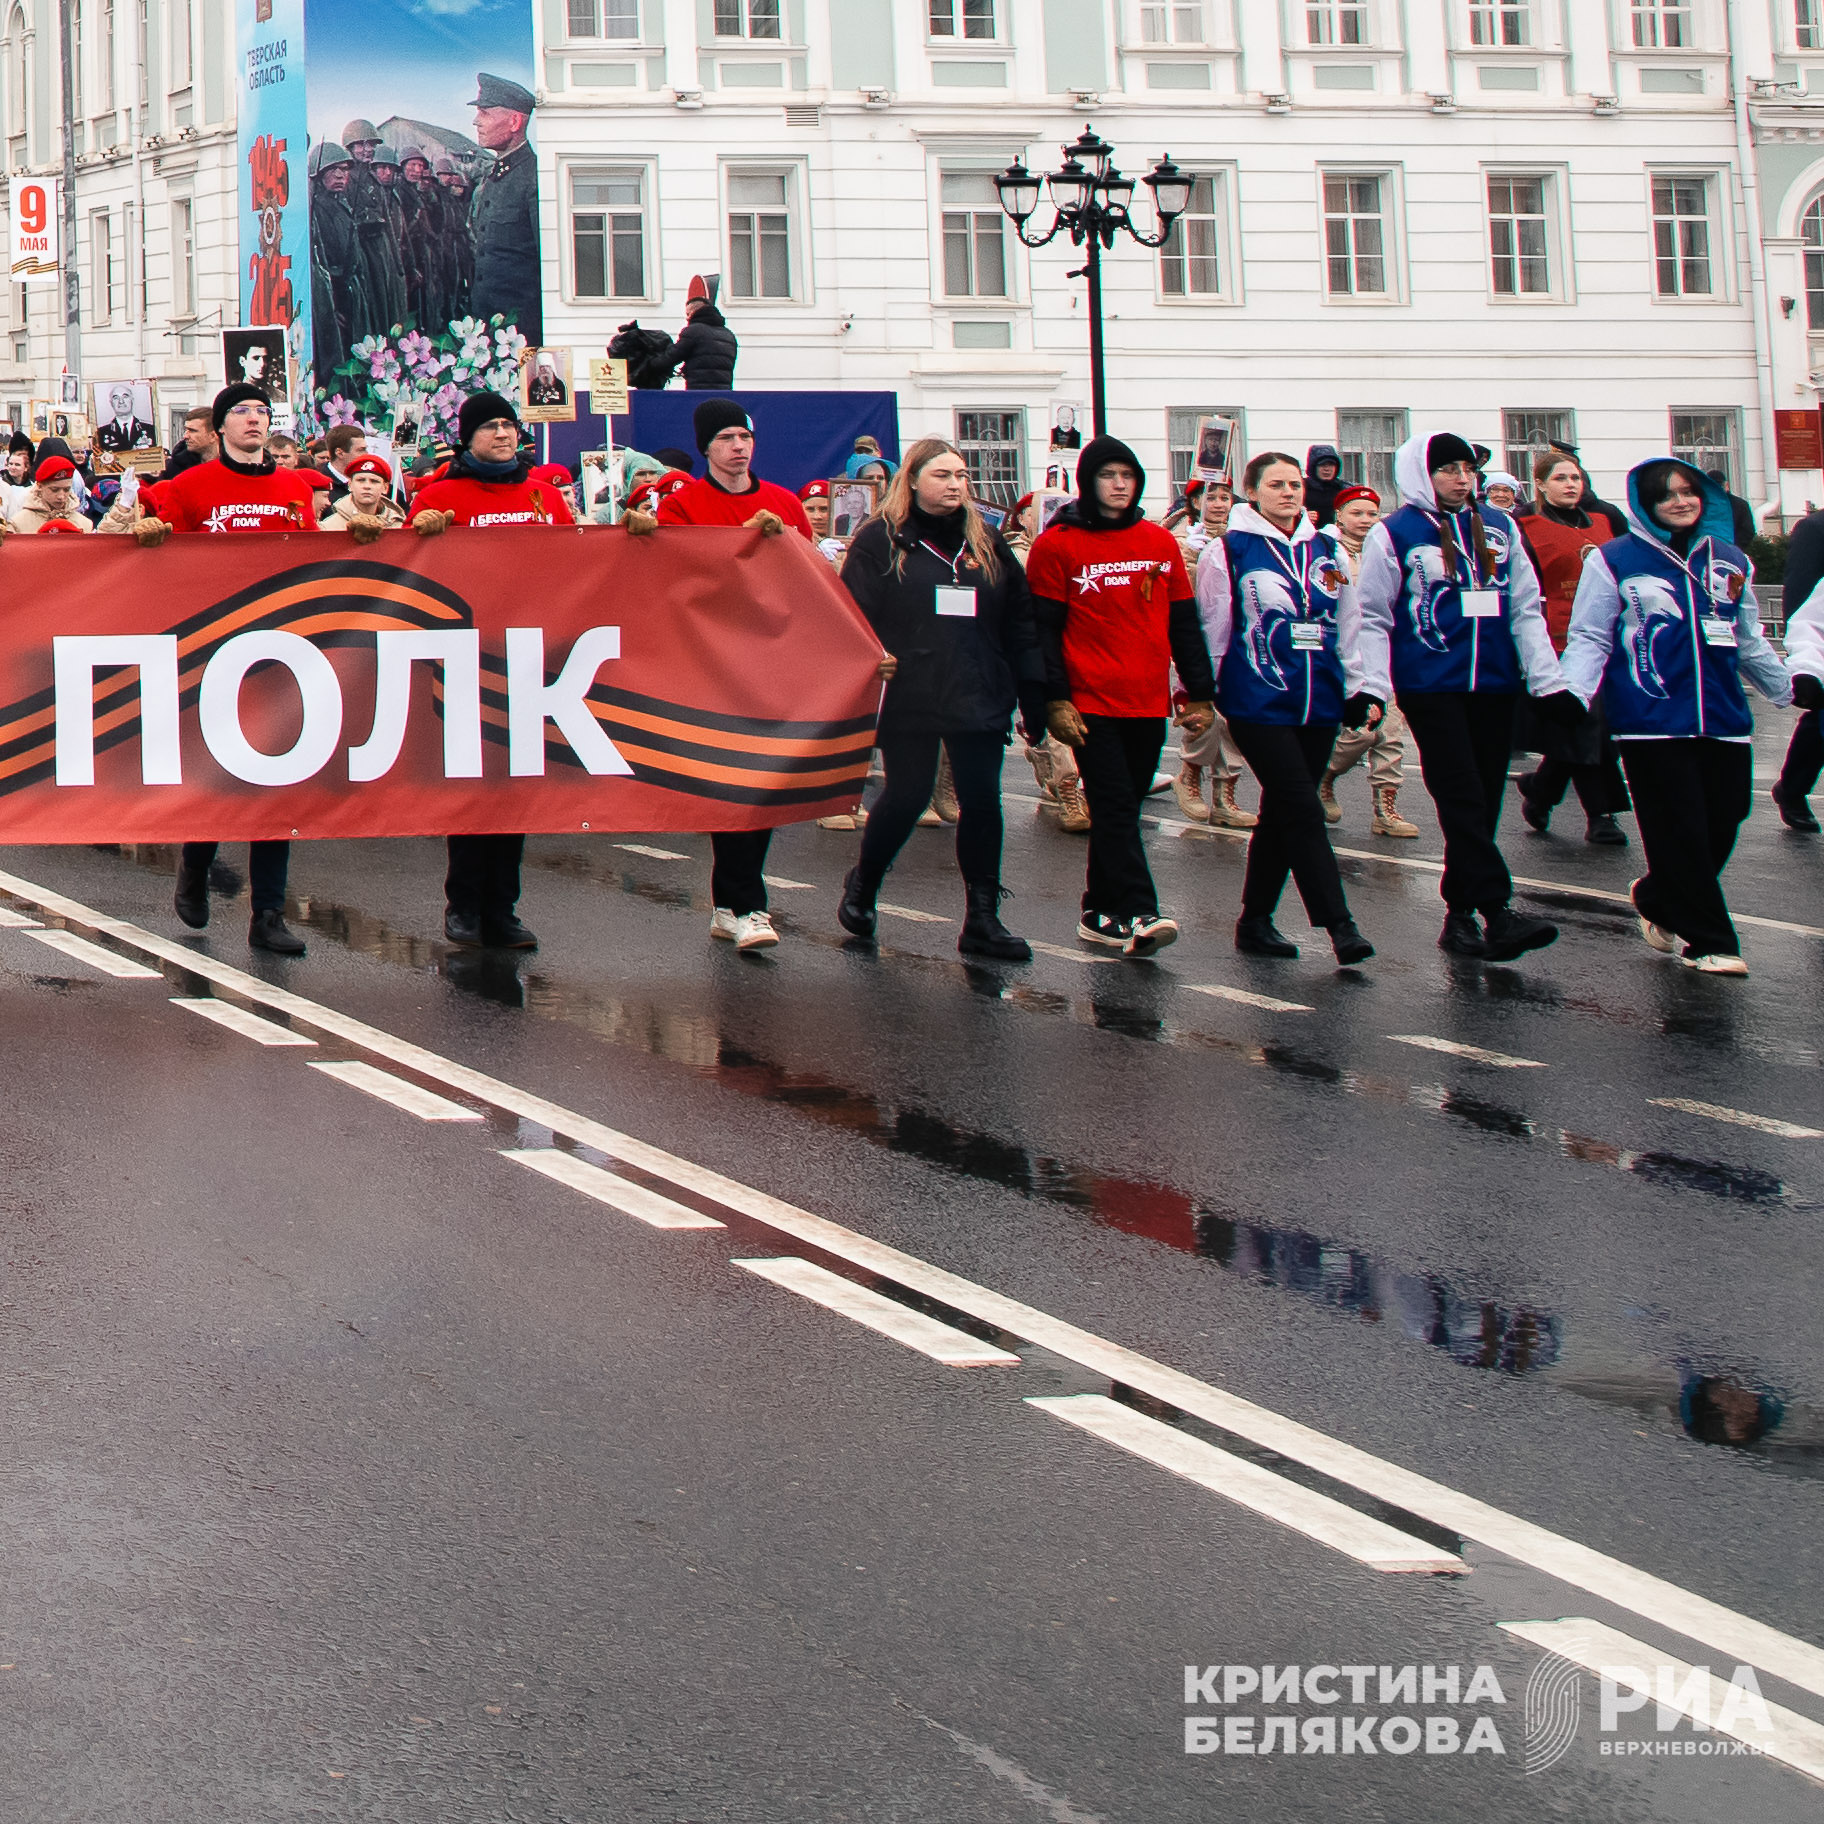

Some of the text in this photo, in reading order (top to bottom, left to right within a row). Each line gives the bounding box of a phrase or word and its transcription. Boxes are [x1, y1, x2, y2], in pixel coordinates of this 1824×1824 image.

[247, 39, 287, 68] ТВЕРСКАЯ
[249, 64, 286, 91] ОБЛАСТЬ
[20, 185, 46, 234] 9
[20, 237, 48, 251] МАЯ
[232, 517, 261, 527] ПОЛК
[1104, 575, 1130, 586] ПОЛК
[53, 626, 634, 787] ПОЛК
